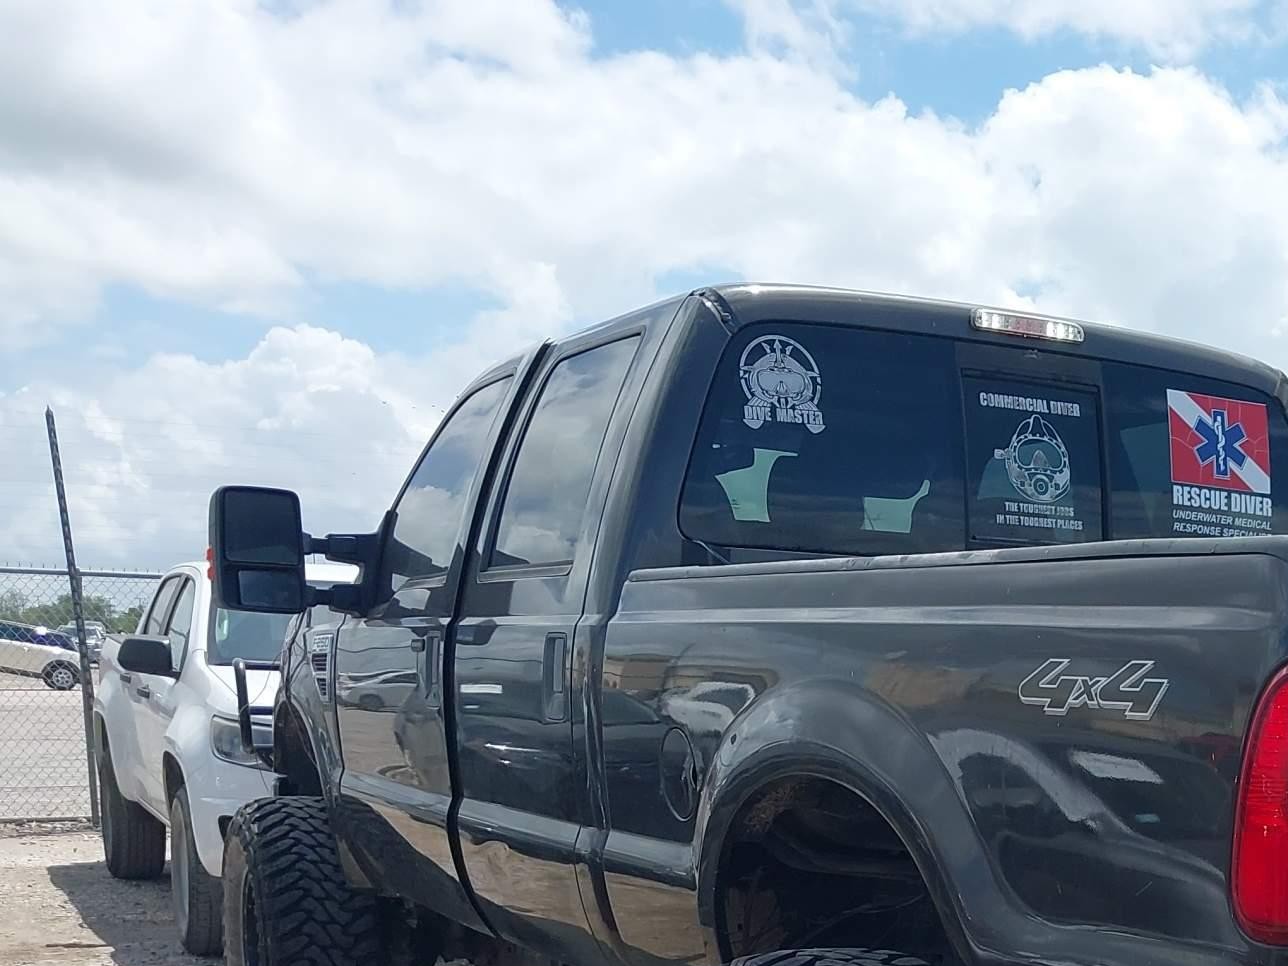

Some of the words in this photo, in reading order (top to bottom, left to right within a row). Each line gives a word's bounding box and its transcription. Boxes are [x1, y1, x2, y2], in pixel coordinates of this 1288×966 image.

[980, 392, 1049, 413] COMMERCIAL
[1050, 401, 1081, 417] DIVER
[744, 405, 772, 421] DIVE
[776, 408, 824, 425] MASTER
[1004, 501, 1019, 512] THE
[1019, 503, 1056, 515] TOUGHEST
[1173, 485, 1228, 511] RESCUE
[1231, 493, 1272, 517] DIVER
[1005, 514, 1019, 525] THE
[1020, 516, 1056, 529] TOUGHEST
[1056, 519, 1083, 530] PLACES
[1173, 509, 1233, 525] UNDERWATER
[1234, 517, 1272, 530] MEDICAL
[1173, 522, 1221, 536] RESPONSE
[1019, 658, 1169, 720] 4x4
